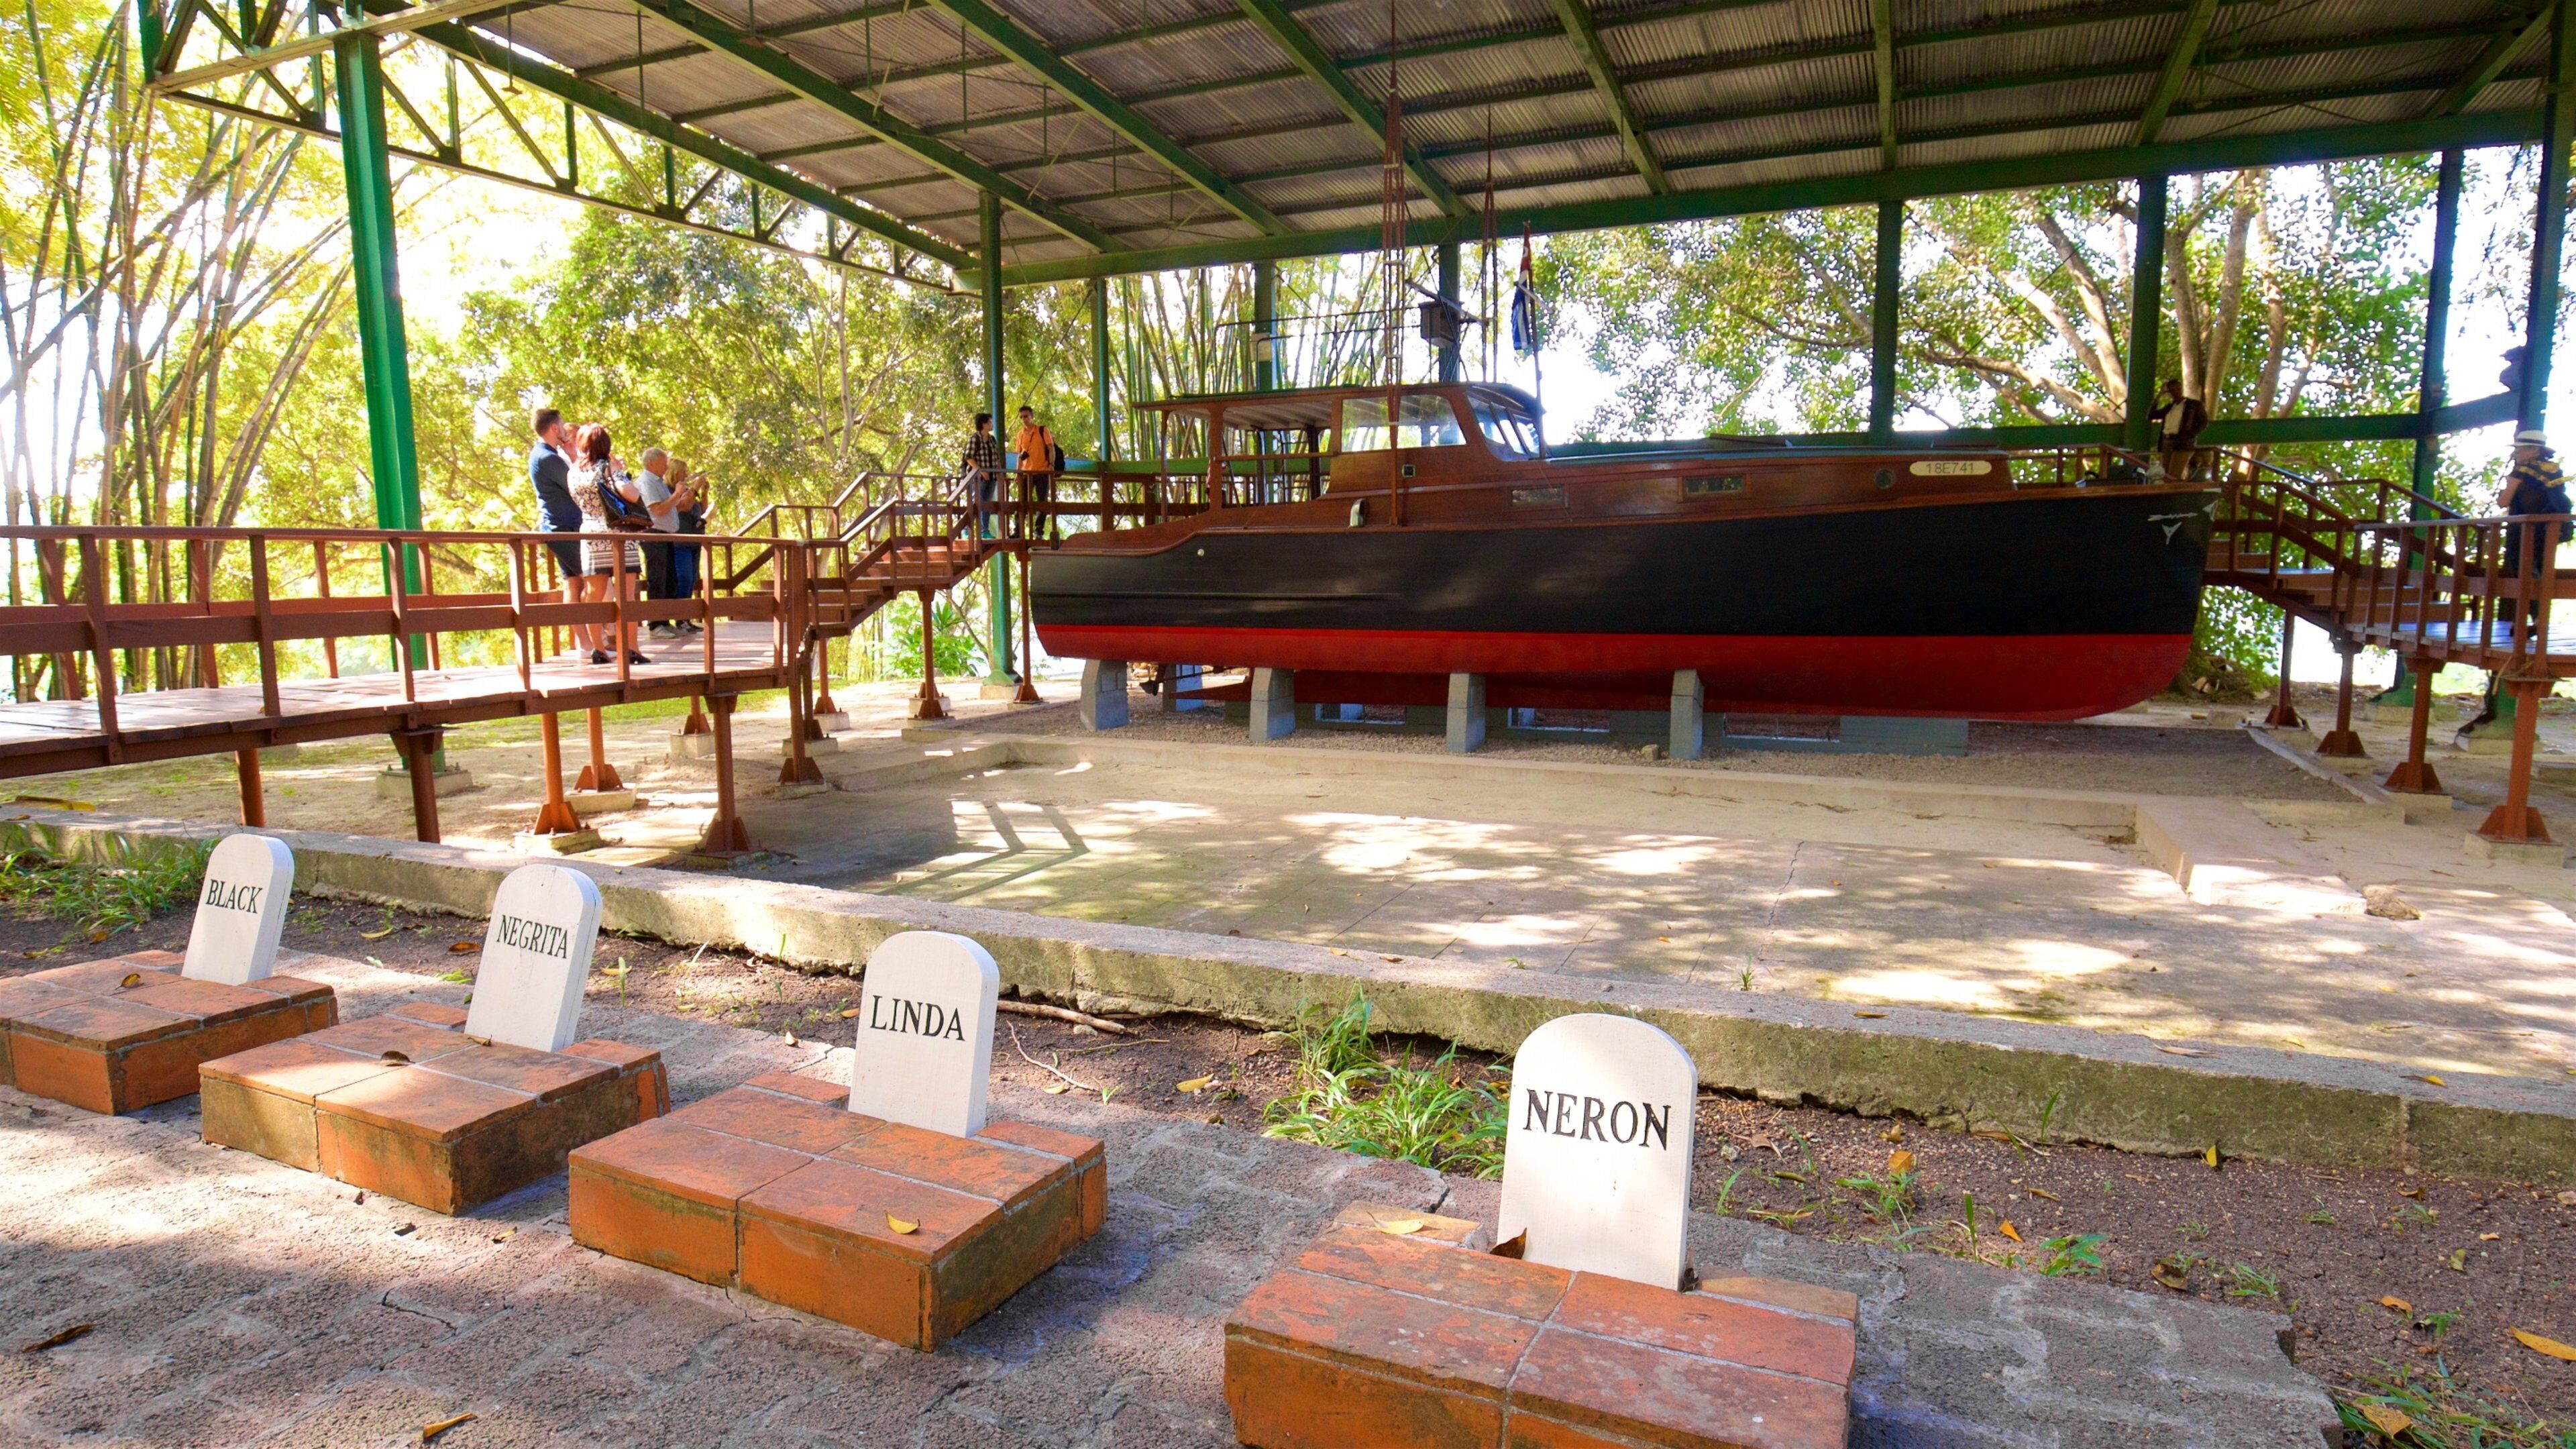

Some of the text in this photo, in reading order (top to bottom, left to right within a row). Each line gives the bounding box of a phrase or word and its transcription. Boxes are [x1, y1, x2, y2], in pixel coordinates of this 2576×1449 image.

[1926, 463, 1974, 474] 18E741
[205, 879, 263, 914] BLACK
[496, 914, 568, 959] NEGRITA
[870, 995, 965, 1041] LINDA
[1523, 1088, 1671, 1151] NERON
